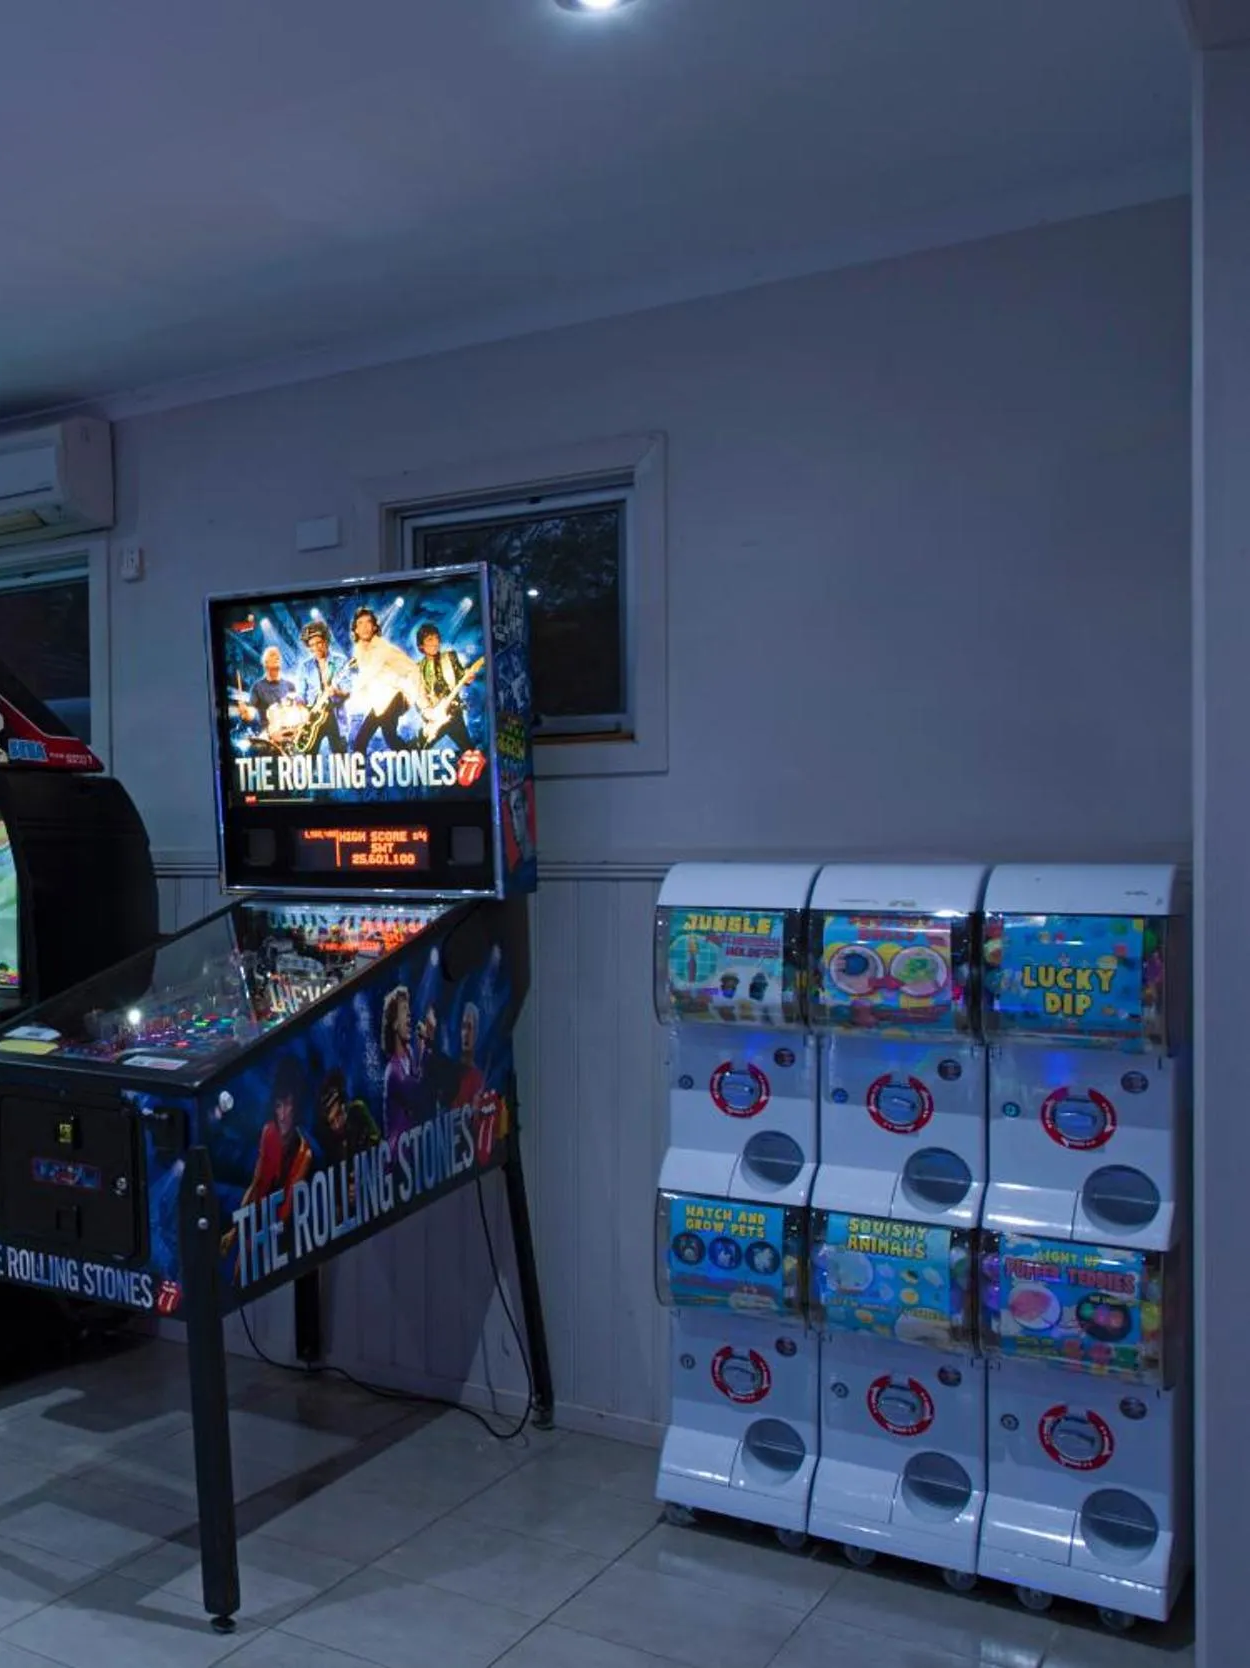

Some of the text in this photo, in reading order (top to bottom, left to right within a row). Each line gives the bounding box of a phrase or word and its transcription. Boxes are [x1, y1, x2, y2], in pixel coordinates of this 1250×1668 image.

[235, 748, 457, 792] THE ROLLING STONES
[370, 830, 408, 842] SCORE
[682, 913, 772, 935] JUNGLE
[1022, 965, 1118, 993] LUCKY
[1043, 991, 1092, 1016] DIP
[232, 1102, 476, 1289] THE ROLLING STONES
[685, 1204, 766, 1226] HATCH AND
[685, 1218, 765, 1239] GROW PETS
[848, 1217, 928, 1241] SQUISHY
[847, 1234, 927, 1259] ANIMALS
[7, 1245, 80, 1294] ROLLING
[82, 1261, 154, 1309] STONES
[1066, 1267, 1137, 1296] TEDDIES
